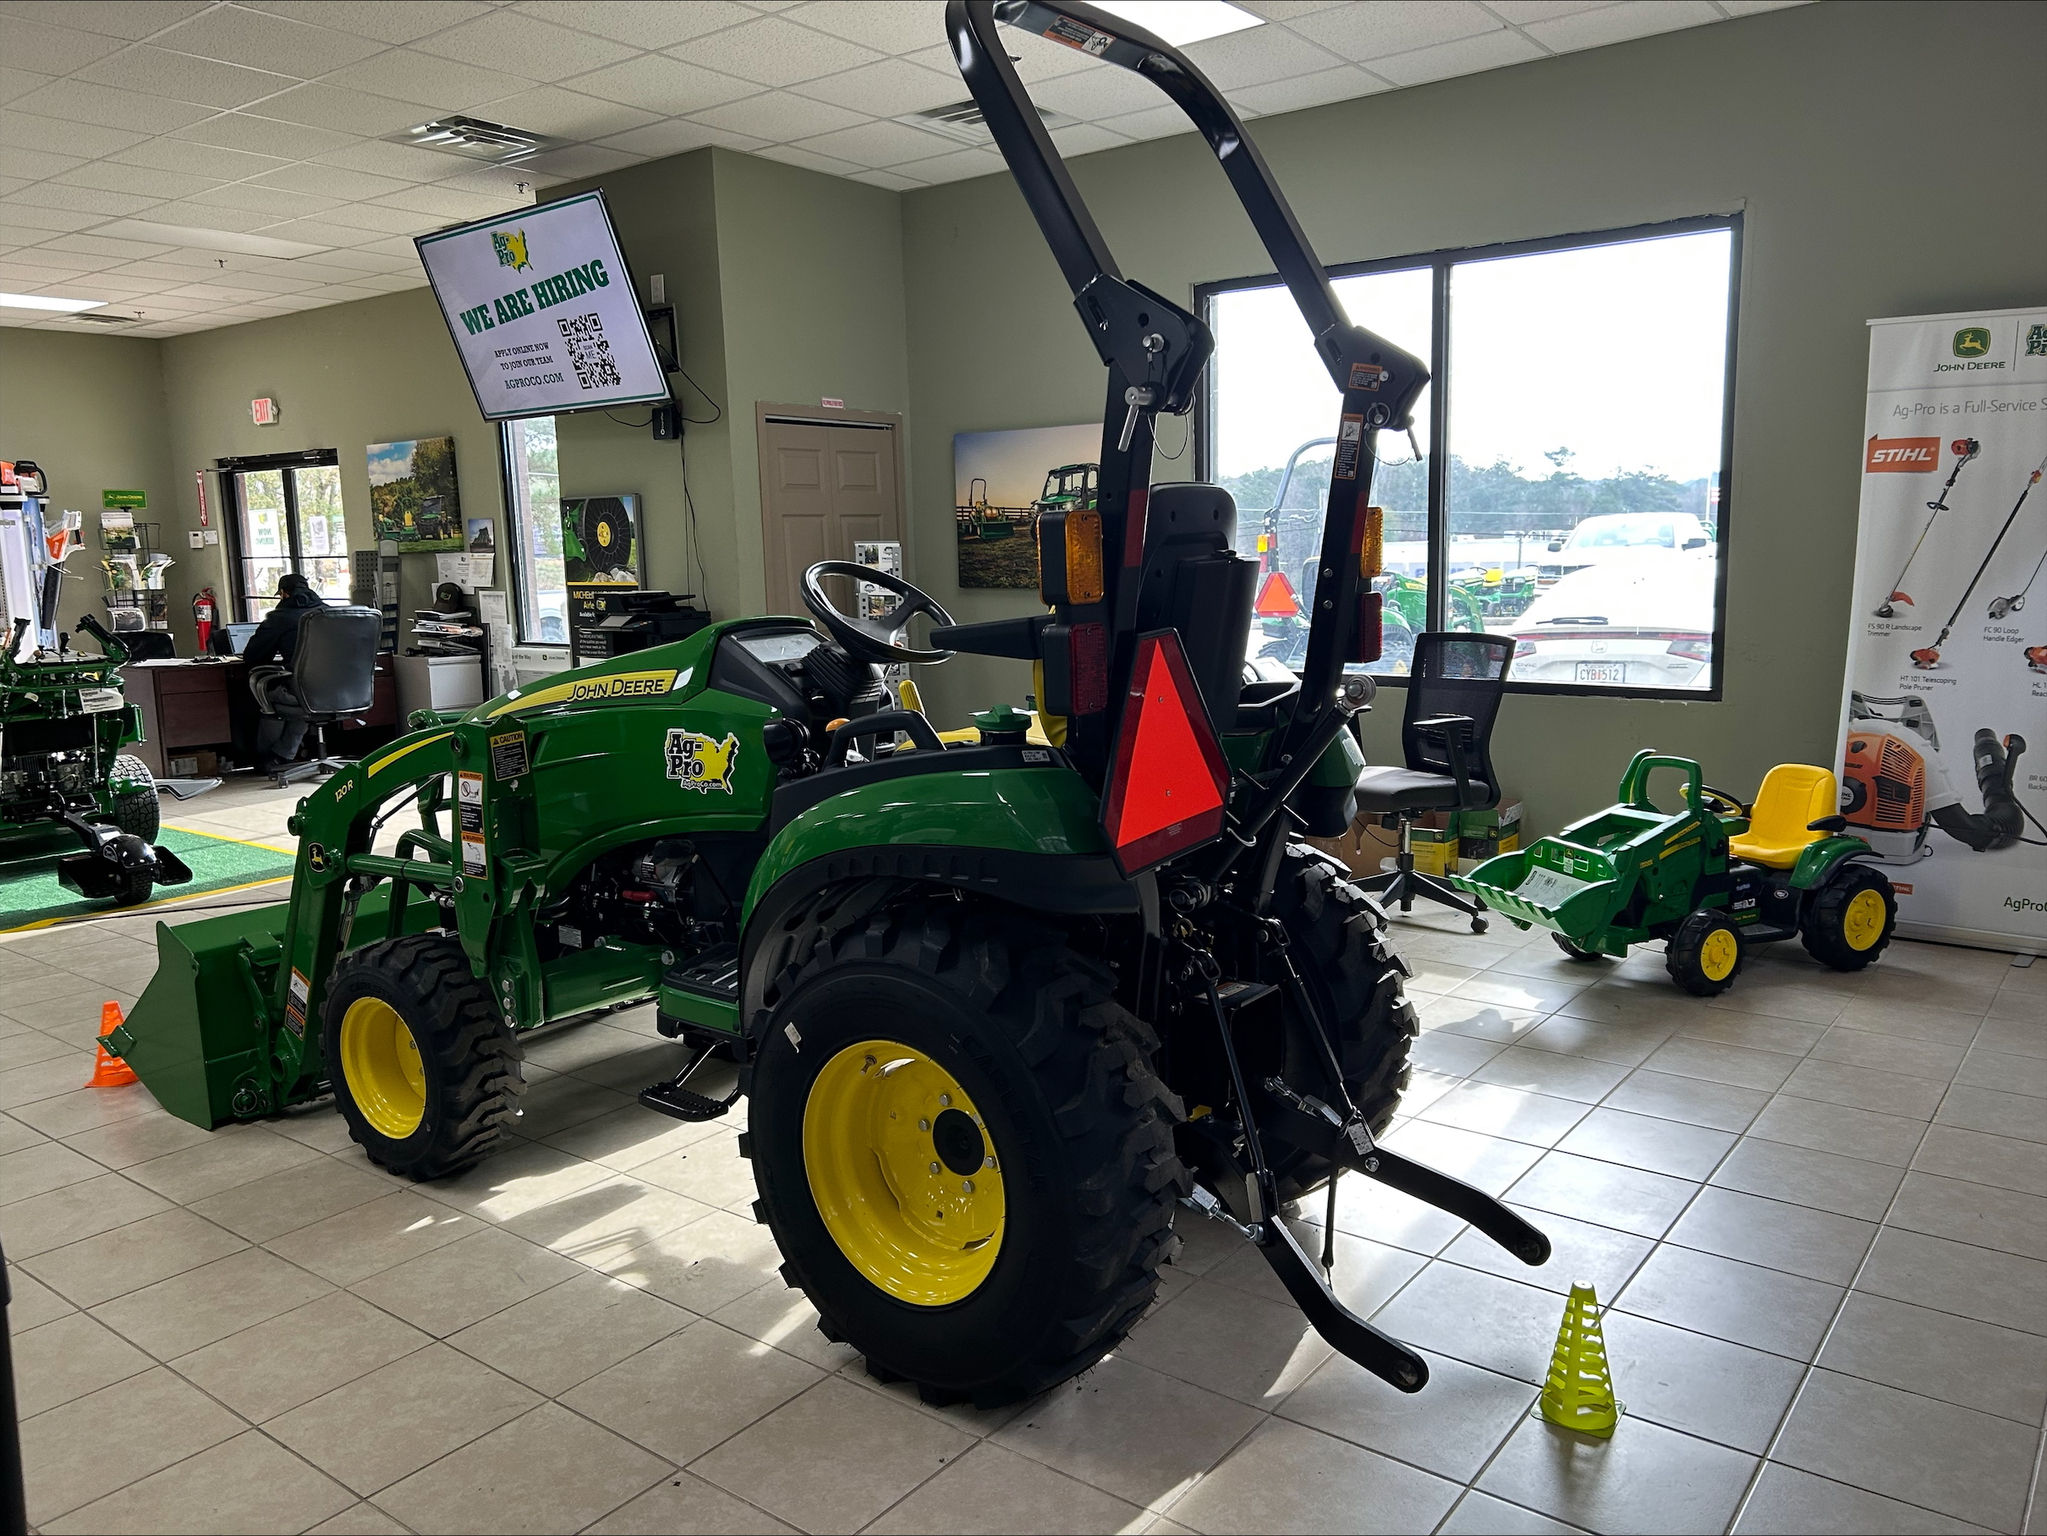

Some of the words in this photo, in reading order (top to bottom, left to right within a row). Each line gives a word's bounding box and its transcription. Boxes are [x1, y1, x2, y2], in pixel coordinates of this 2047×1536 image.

[491, 231, 511, 250] Ag-
[497, 249, 517, 266] Pro
[460, 304, 495, 335] WE
[494, 288, 534, 324] ARE
[531, 259, 610, 310] HIRING
[494, 348, 512, 359] APPLY
[512, 344, 534, 357] ONLINE
[534, 341, 550, 353] NOW
[2027, 340, 2047, 355] Pr
[509, 360, 523, 371] JOIN
[523, 358, 536, 368] OUR
[536, 355, 554, 367] TEAM
[1933, 363, 1965, 373] JOHN
[1967, 361, 2006, 370] DEERE
[504, 373, 564, 390] AGPROCO.COM
[254, 400, 270, 422] EXIT
[1893, 402, 1936, 420] Ag-Pro
[1939, 403, 1949, 414] is
[1952, 404, 1960, 413] a
[1964, 399, 2037, 413] Full-Service
[1871, 447, 1932, 463] STIHL
[573, 591, 595, 600] MICHELI
[1891, 624, 1922, 632] Landscape
[1984, 626, 1993, 634] FC
[2003, 627, 2020, 635] Loop
[2006, 636, 2025, 644] Edger
[1899, 683, 1913, 691] Pole
[1922, 676, 1957, 686] Telescoping
[567, 683, 609, 700] JOHN
[611, 679, 665, 696] DEERE
[668, 733, 703, 759] Ag-
[669, 755, 704, 778] Pro
